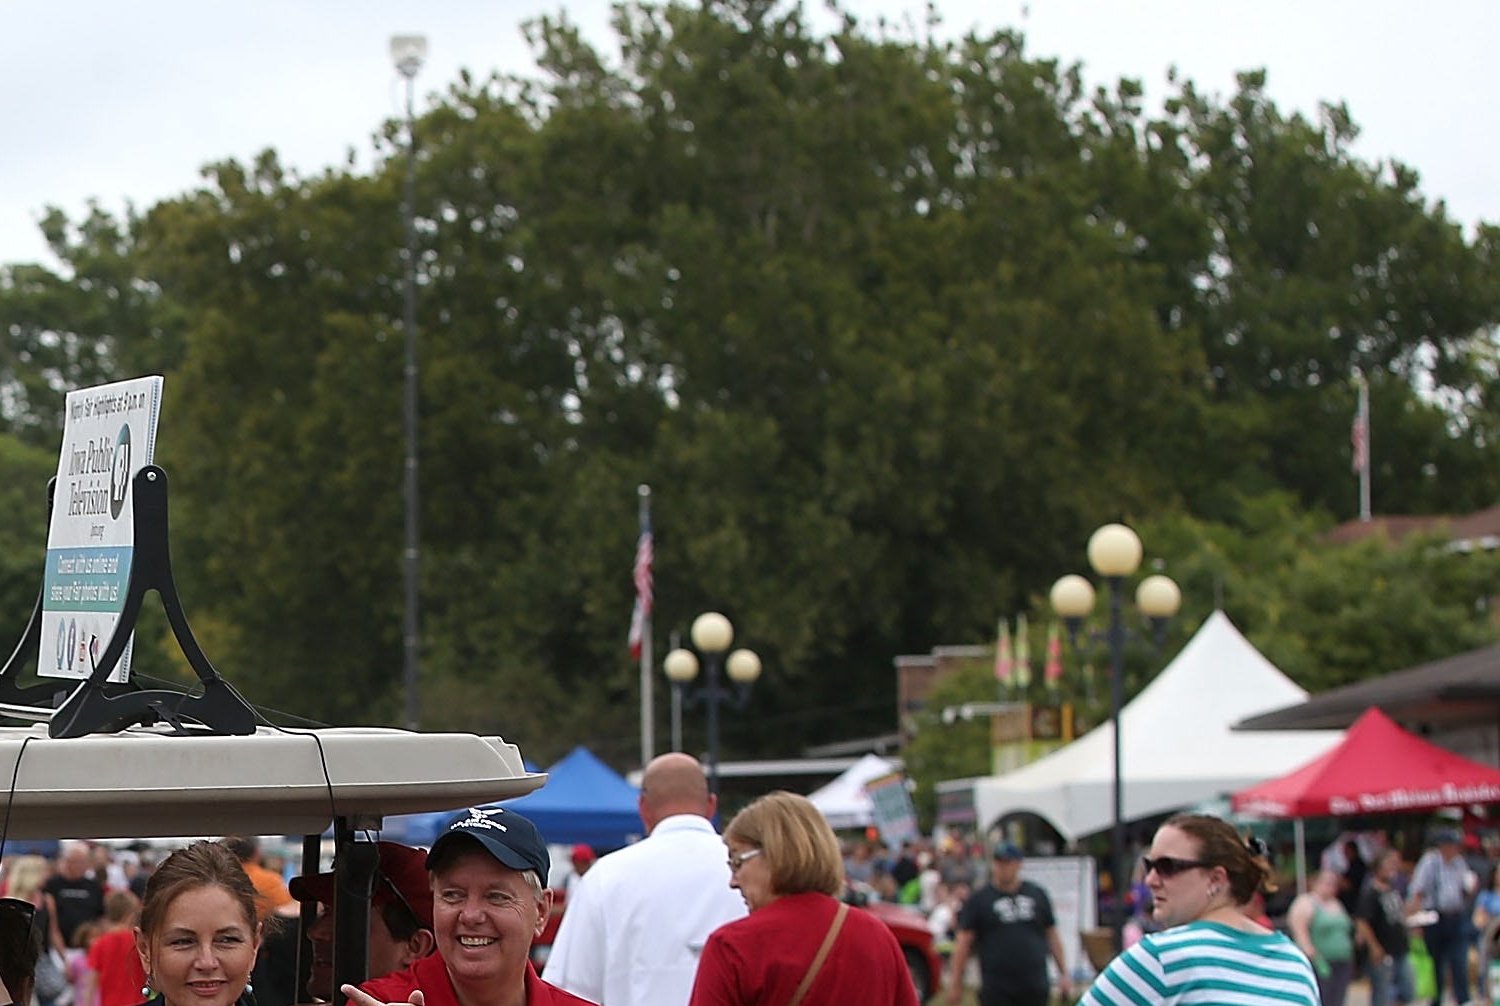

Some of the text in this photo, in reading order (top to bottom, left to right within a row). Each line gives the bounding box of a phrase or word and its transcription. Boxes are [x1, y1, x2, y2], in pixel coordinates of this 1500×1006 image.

[68, 437, 114, 476] Iowa Public
[68, 480, 109, 516] Television
